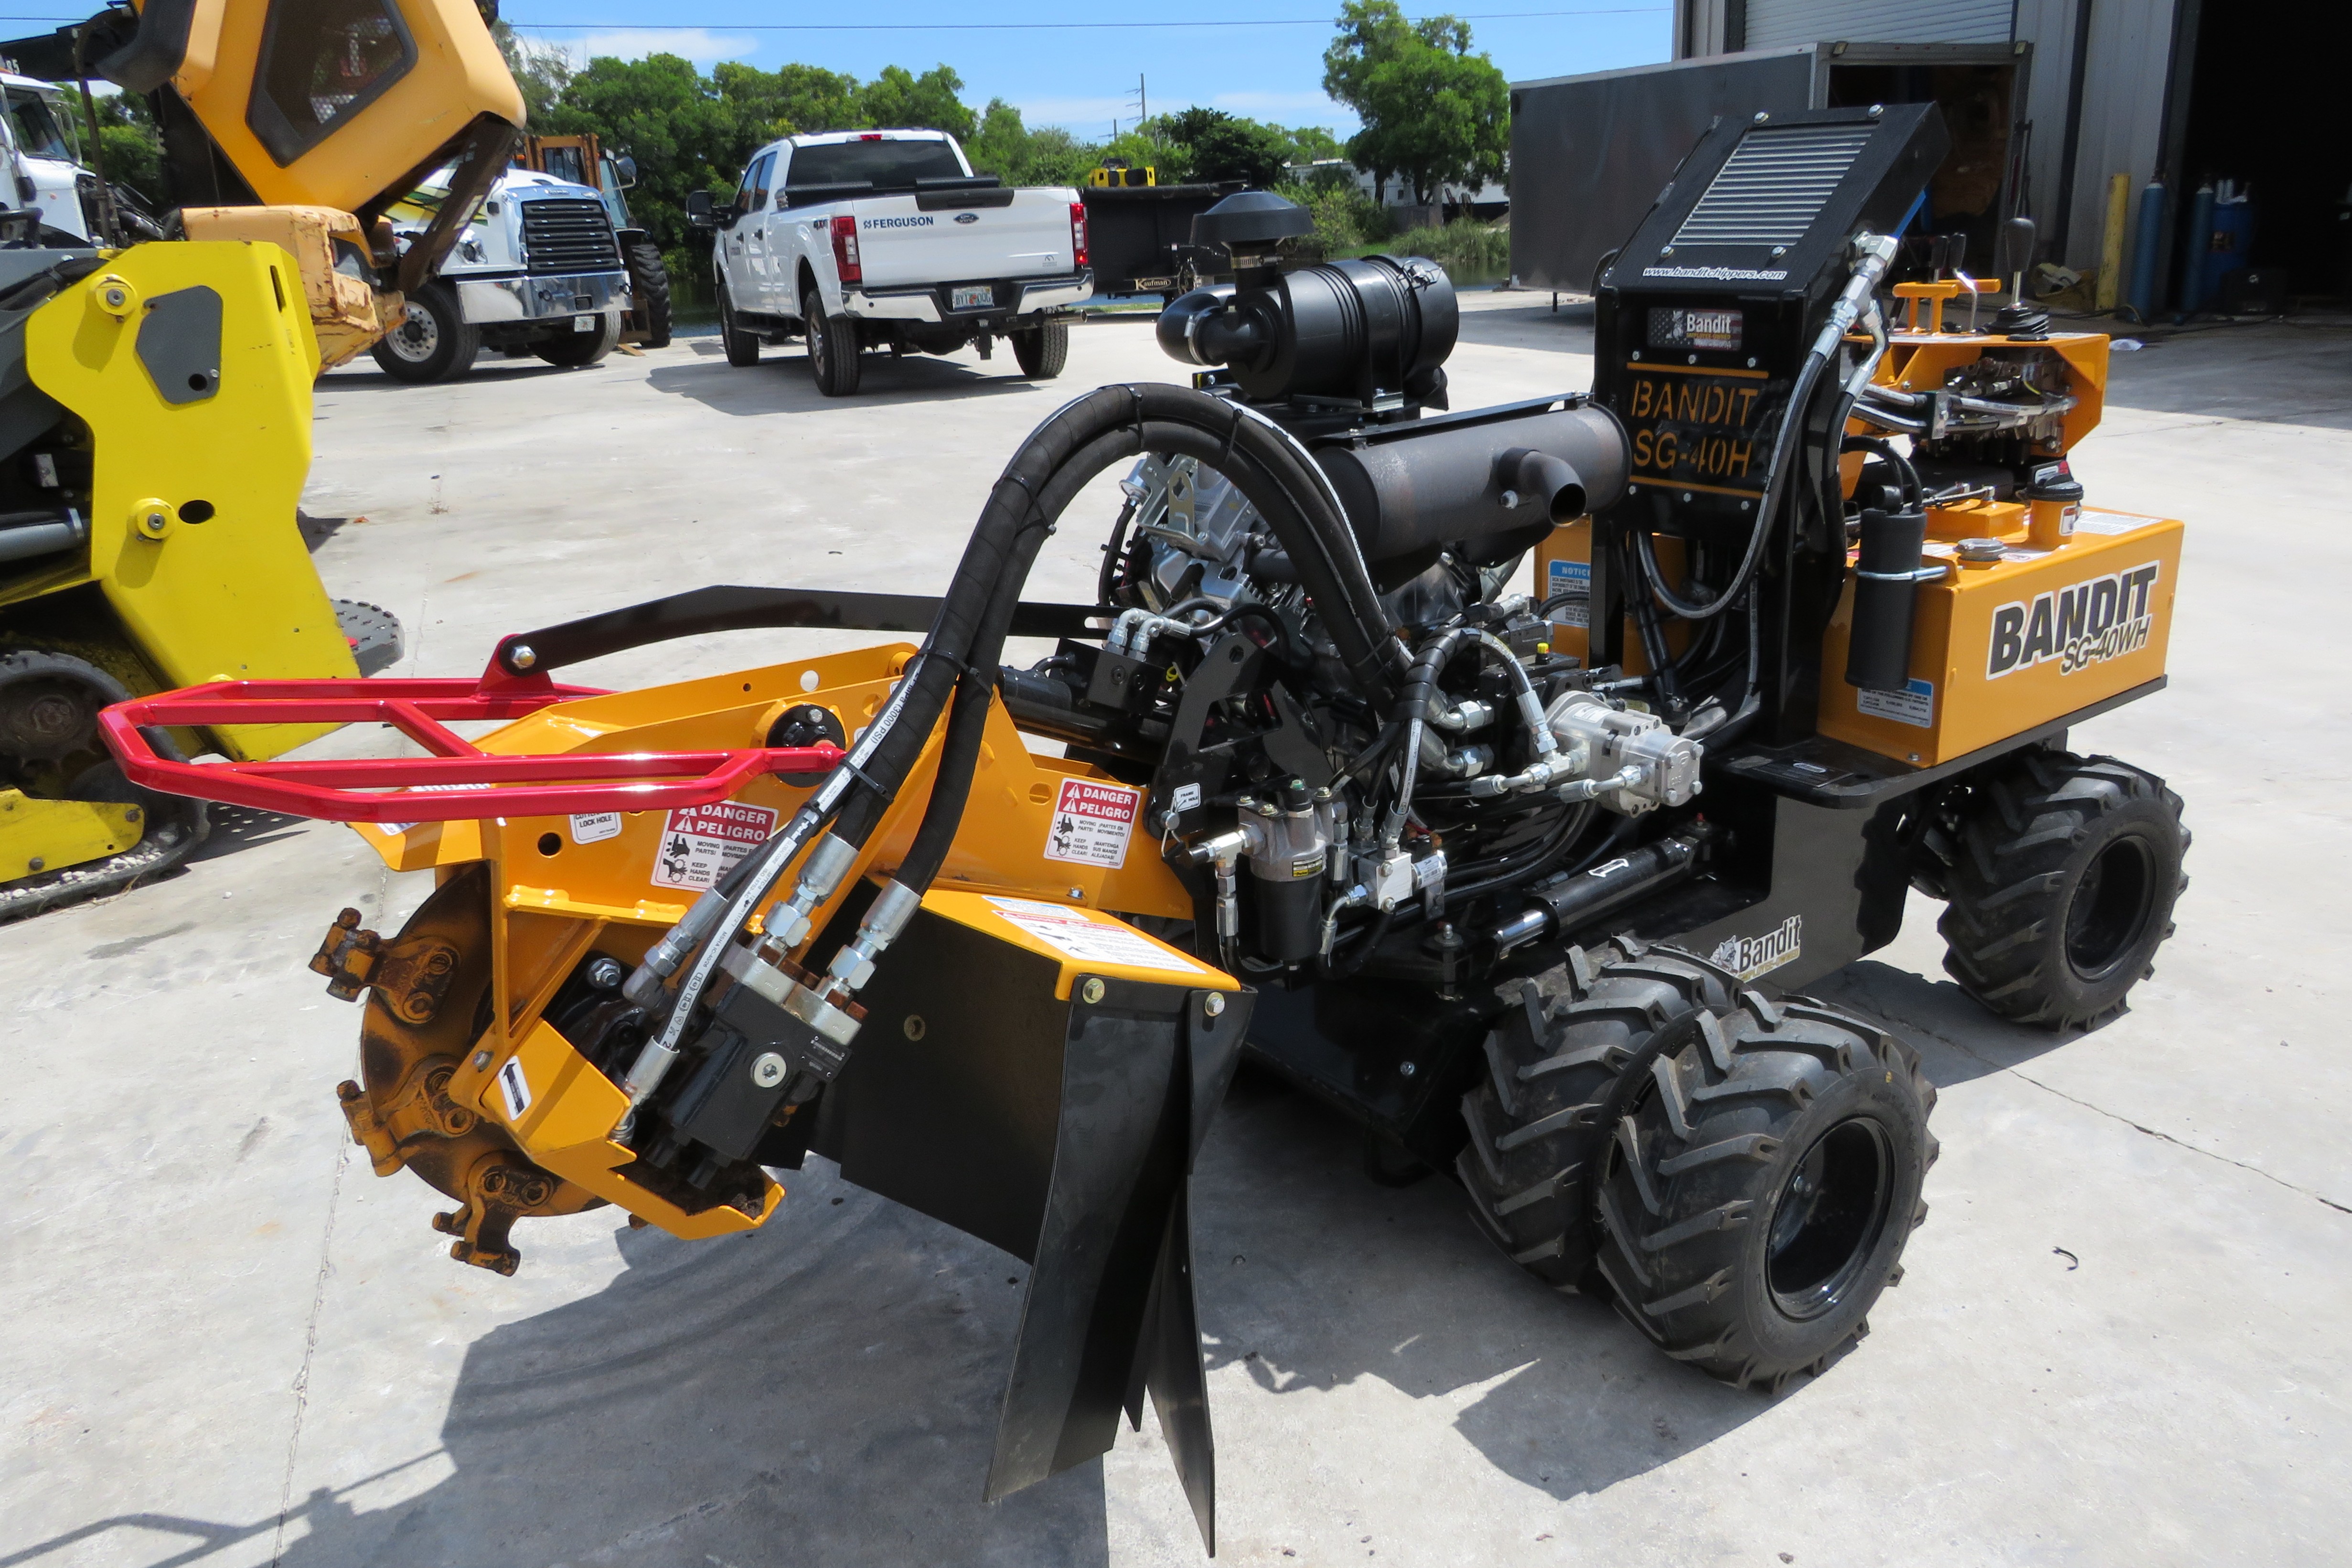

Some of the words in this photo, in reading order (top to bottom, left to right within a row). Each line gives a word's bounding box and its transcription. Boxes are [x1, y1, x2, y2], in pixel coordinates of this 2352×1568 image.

[874, 216, 934, 229] FERGUSON
[1643, 267, 1787, 280] www.banditchippers.com
[1135, 278, 1169, 290] Kaufman
[1687, 314, 1732, 333] Bandit
[1631, 380, 1758, 426] BANDIT
[1634, 429, 1752, 478] SG-40H
[1989, 565, 2157, 674] BANDIT
[2061, 616, 2151, 674] SG-40WH
[884, 704, 903, 726] (3000
[870, 726, 887, 744] PSI)
[1083, 787, 1133, 805] DANGER
[701, 804, 767, 824] DANGER
[1079, 801, 1130, 820] PELIGRO
[579, 819, 596, 828] LOCK
[597, 814, 612, 824] HOLE
[696, 821, 765, 841] PELIGRO
[1097, 829, 1125, 837] MOVIMIENTO!
[697, 841, 720, 849] MOVING
[715, 931, 727, 947] MSHA
[1739, 916, 1801, 973] Bandit
